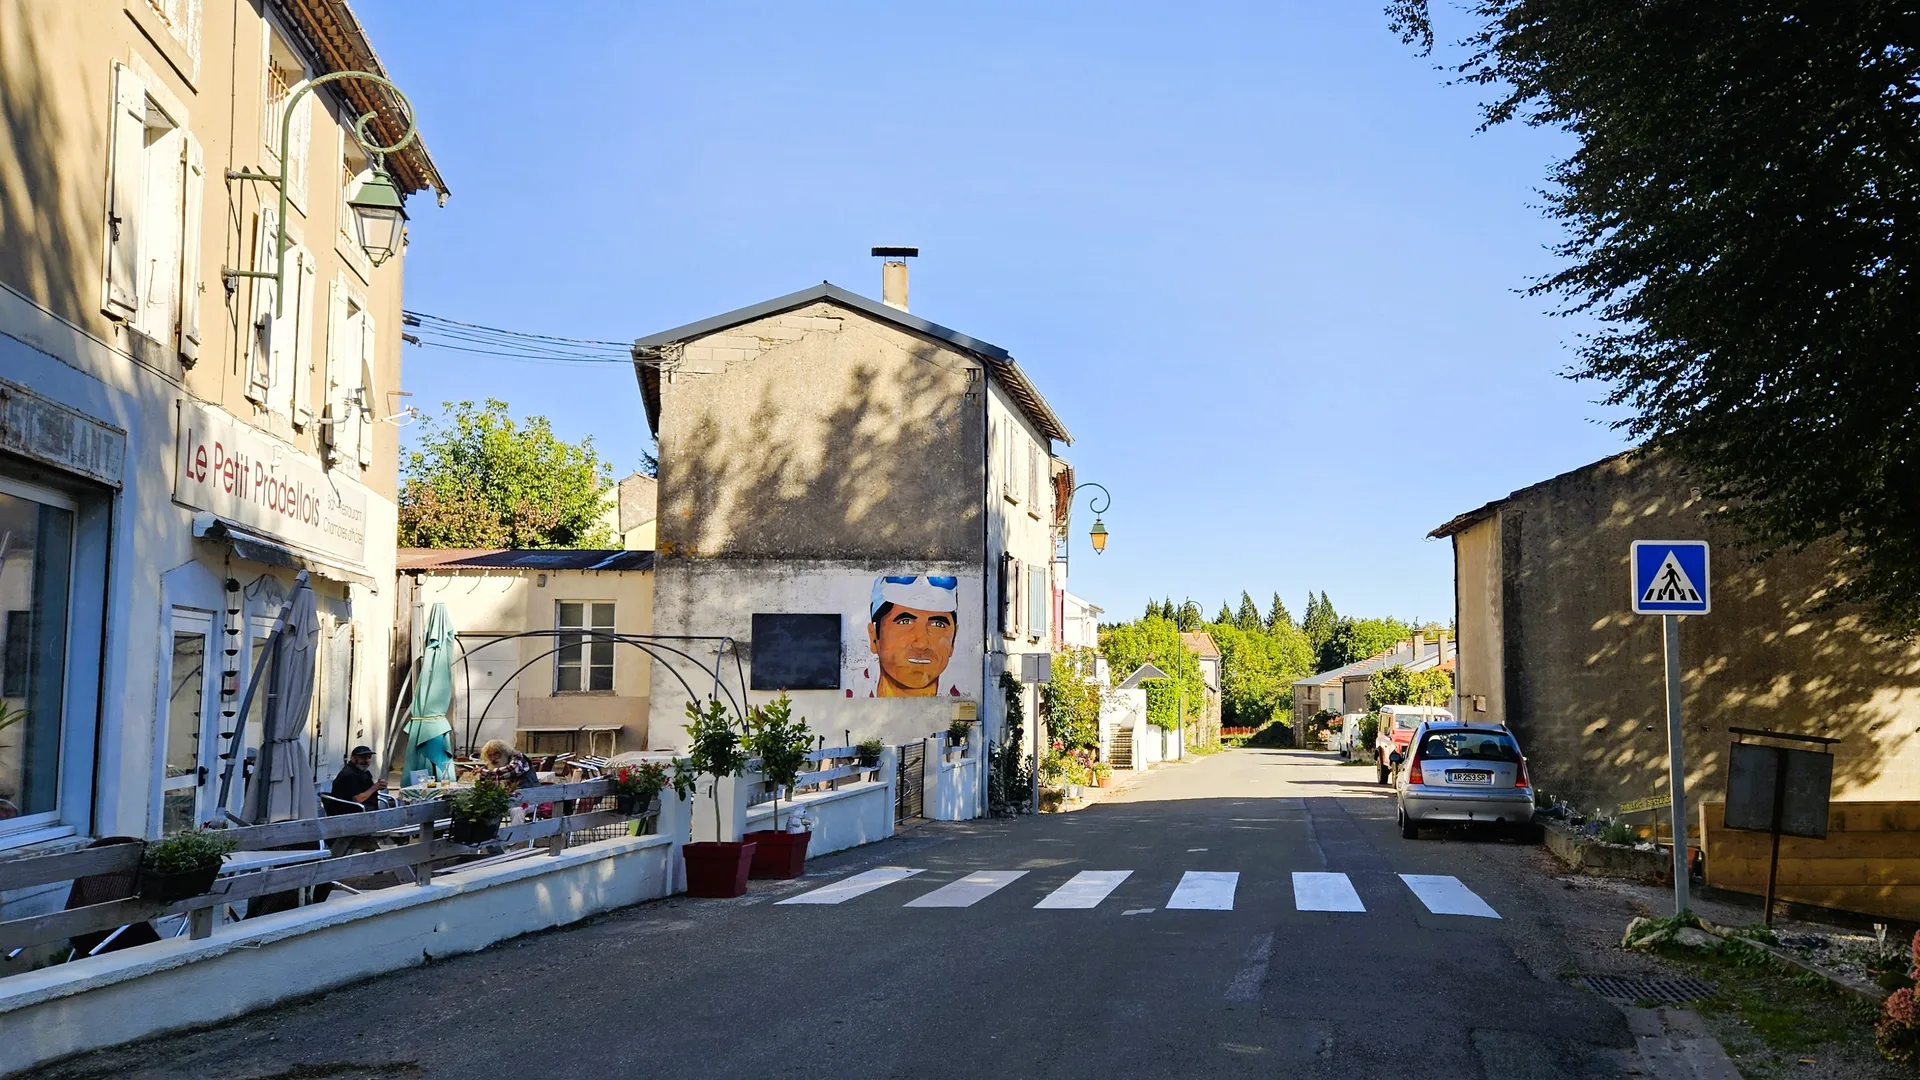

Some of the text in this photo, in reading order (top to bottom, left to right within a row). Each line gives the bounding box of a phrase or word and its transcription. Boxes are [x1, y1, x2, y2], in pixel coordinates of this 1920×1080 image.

[186, 428, 320, 528] Le Petit Pradellois
